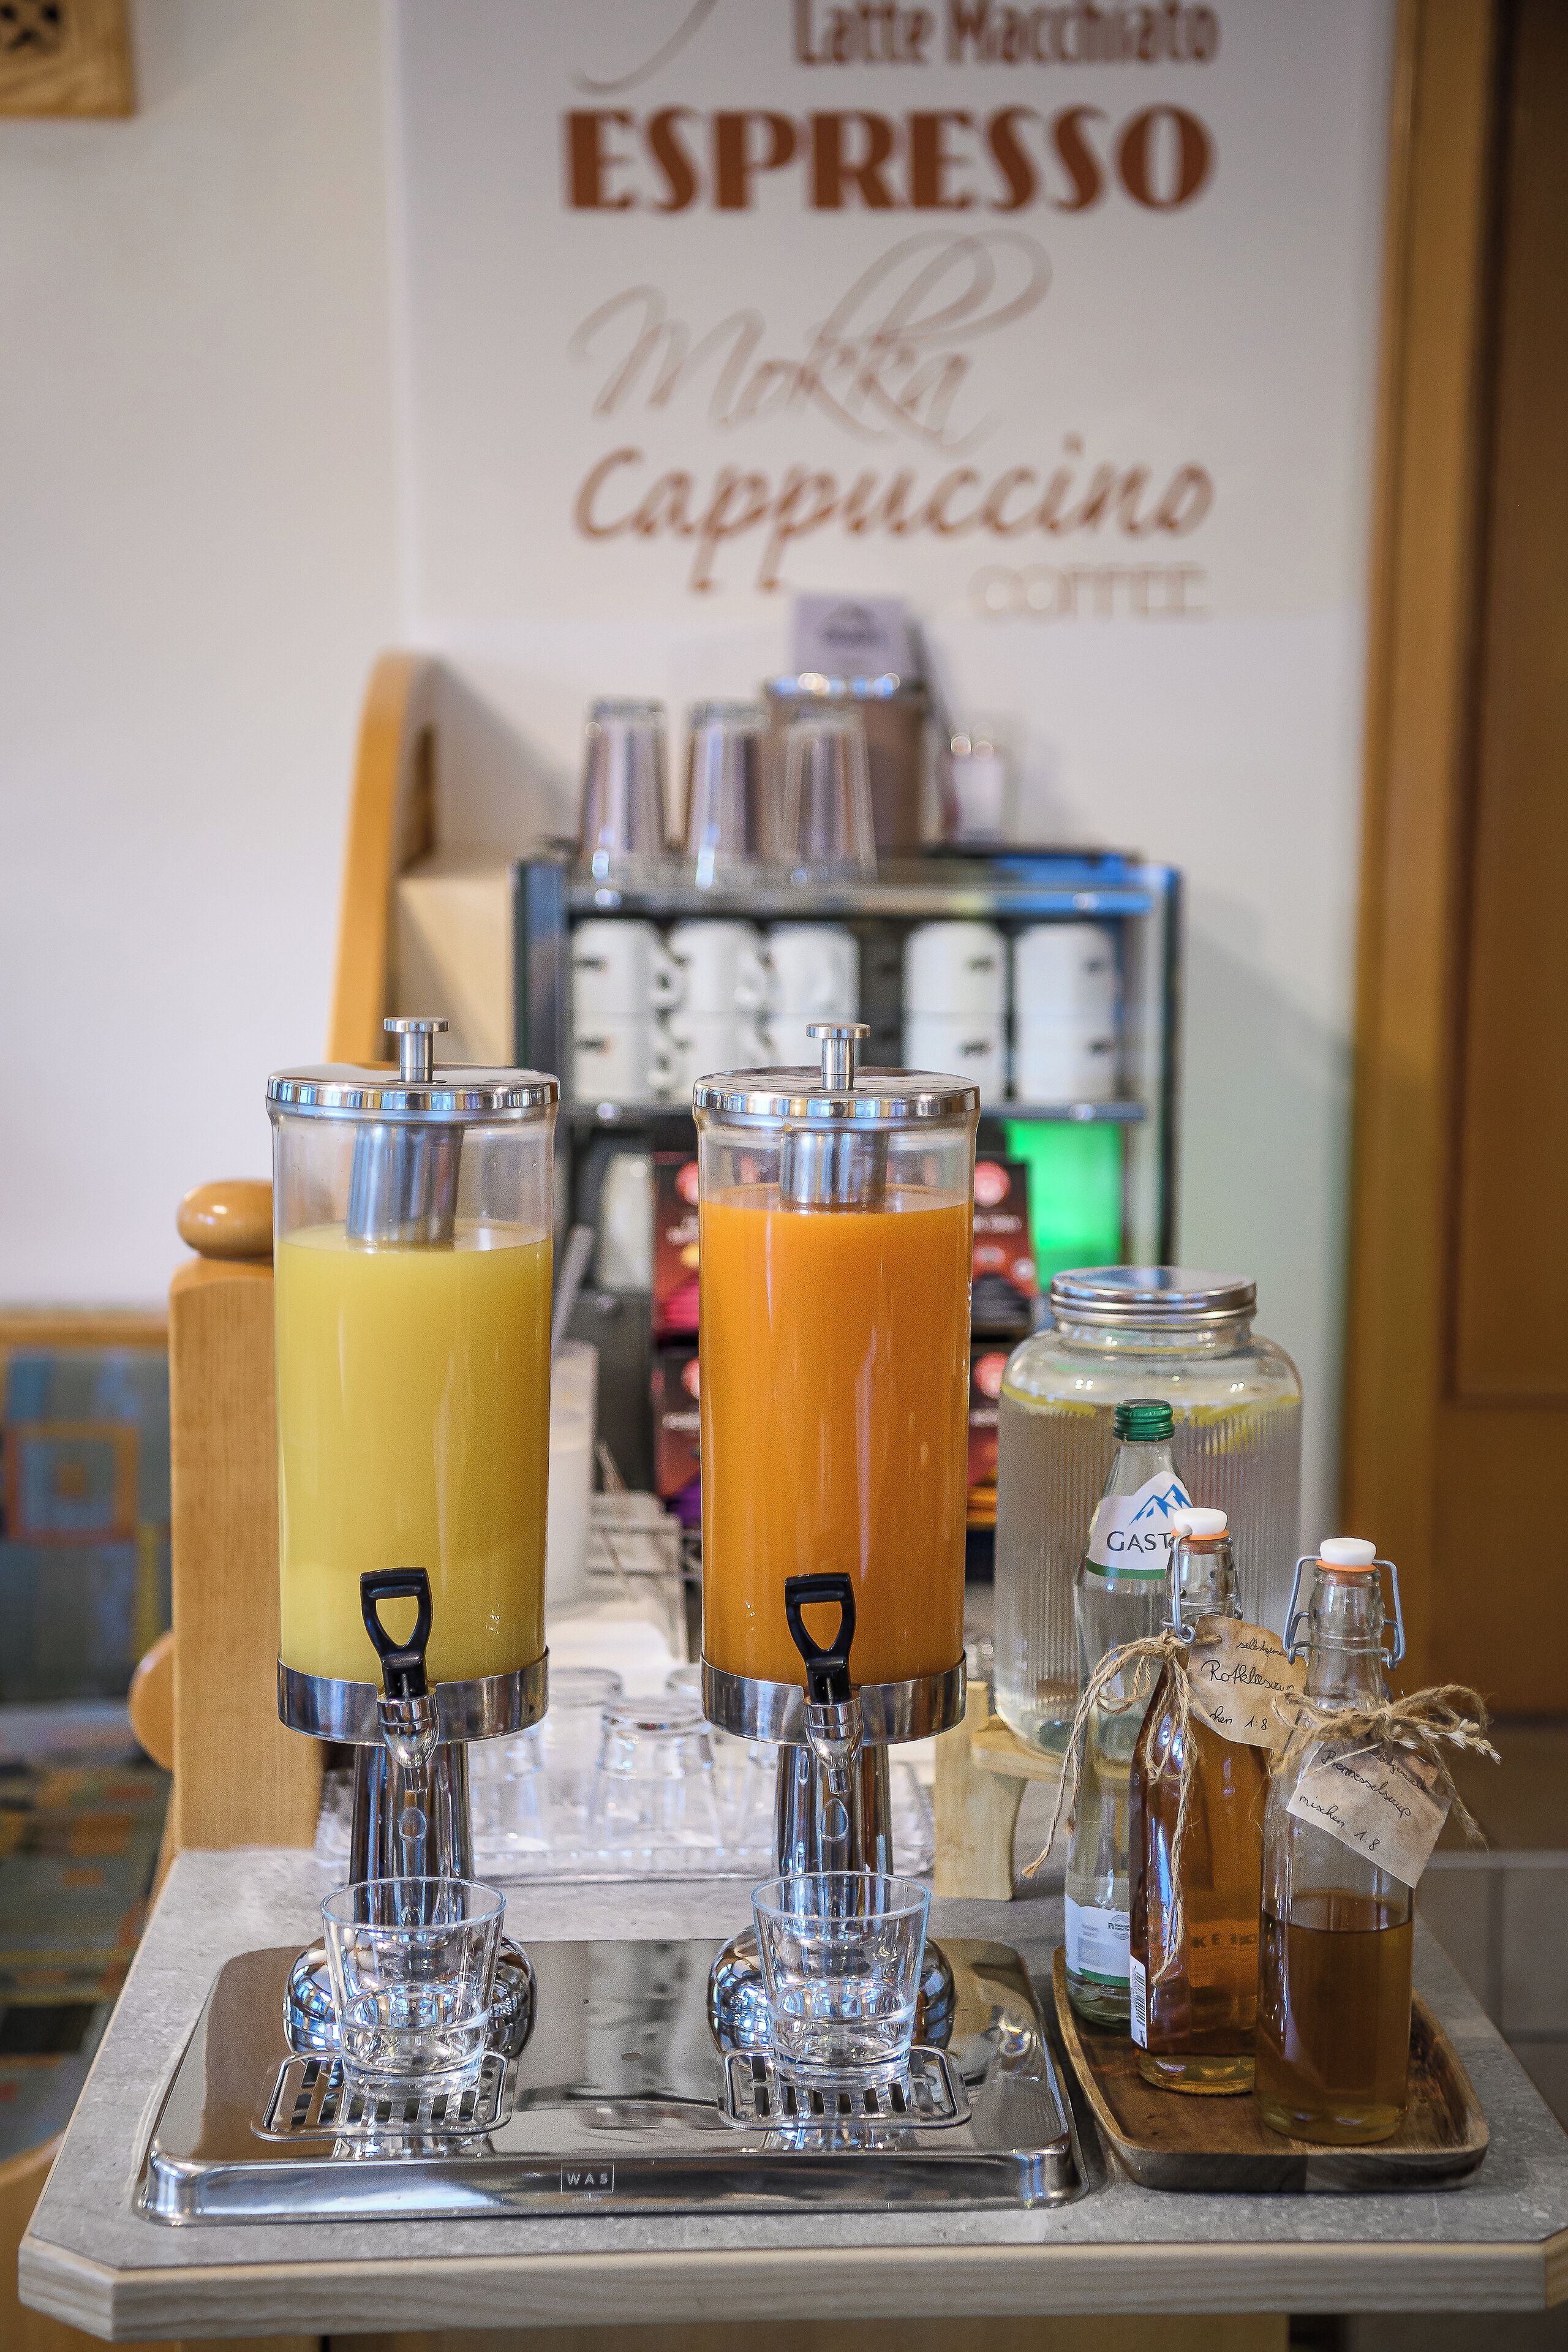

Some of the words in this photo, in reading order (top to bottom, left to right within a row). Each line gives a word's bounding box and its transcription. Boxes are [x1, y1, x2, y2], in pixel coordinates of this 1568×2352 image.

[944, 0, 1219, 66] Macchiato
[562, 103, 1215, 214] ESPRESSO
[571, 432, 1215, 593] Cappuccino
[1298, 1795, 1346, 1828] mischen
[566, 2172, 609, 2186] WAS
